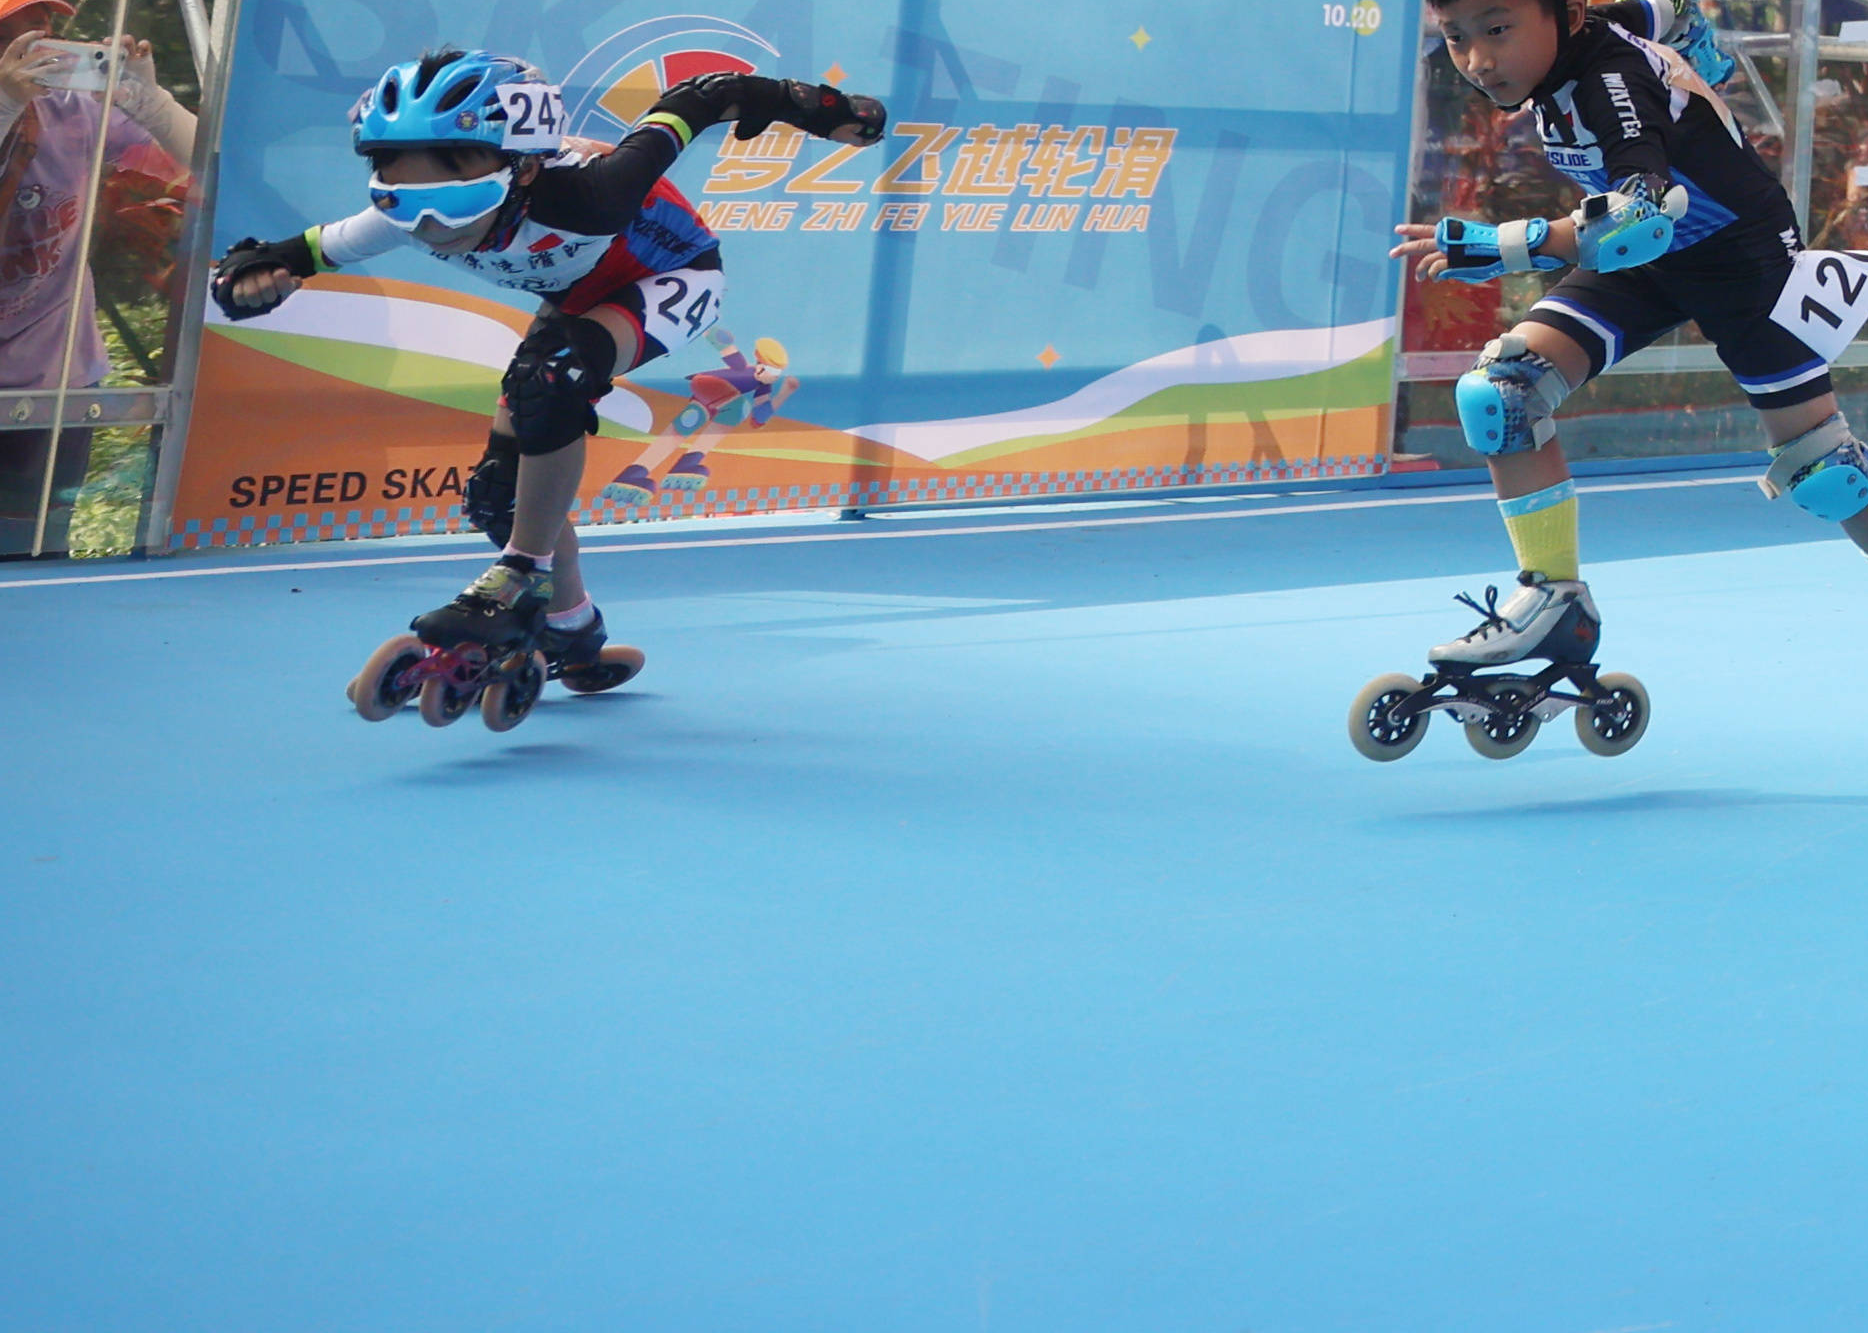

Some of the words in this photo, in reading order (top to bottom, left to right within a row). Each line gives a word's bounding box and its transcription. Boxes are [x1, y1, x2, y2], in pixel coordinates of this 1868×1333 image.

[1322, 4, 1381, 30] 10.20
[1600, 71, 1641, 140] MATTER
[702, 120, 1179, 199] 梦之飞越轮滑
[696, 200, 798, 231] MENG
[801, 202, 868, 231] ZHI
[872, 202, 932, 231] FEI
[942, 202, 1008, 232] YUE
[1011, 202, 1081, 232] LUN
[1083, 203, 1151, 232] HUA
[229, 470, 368, 509] SPEED
